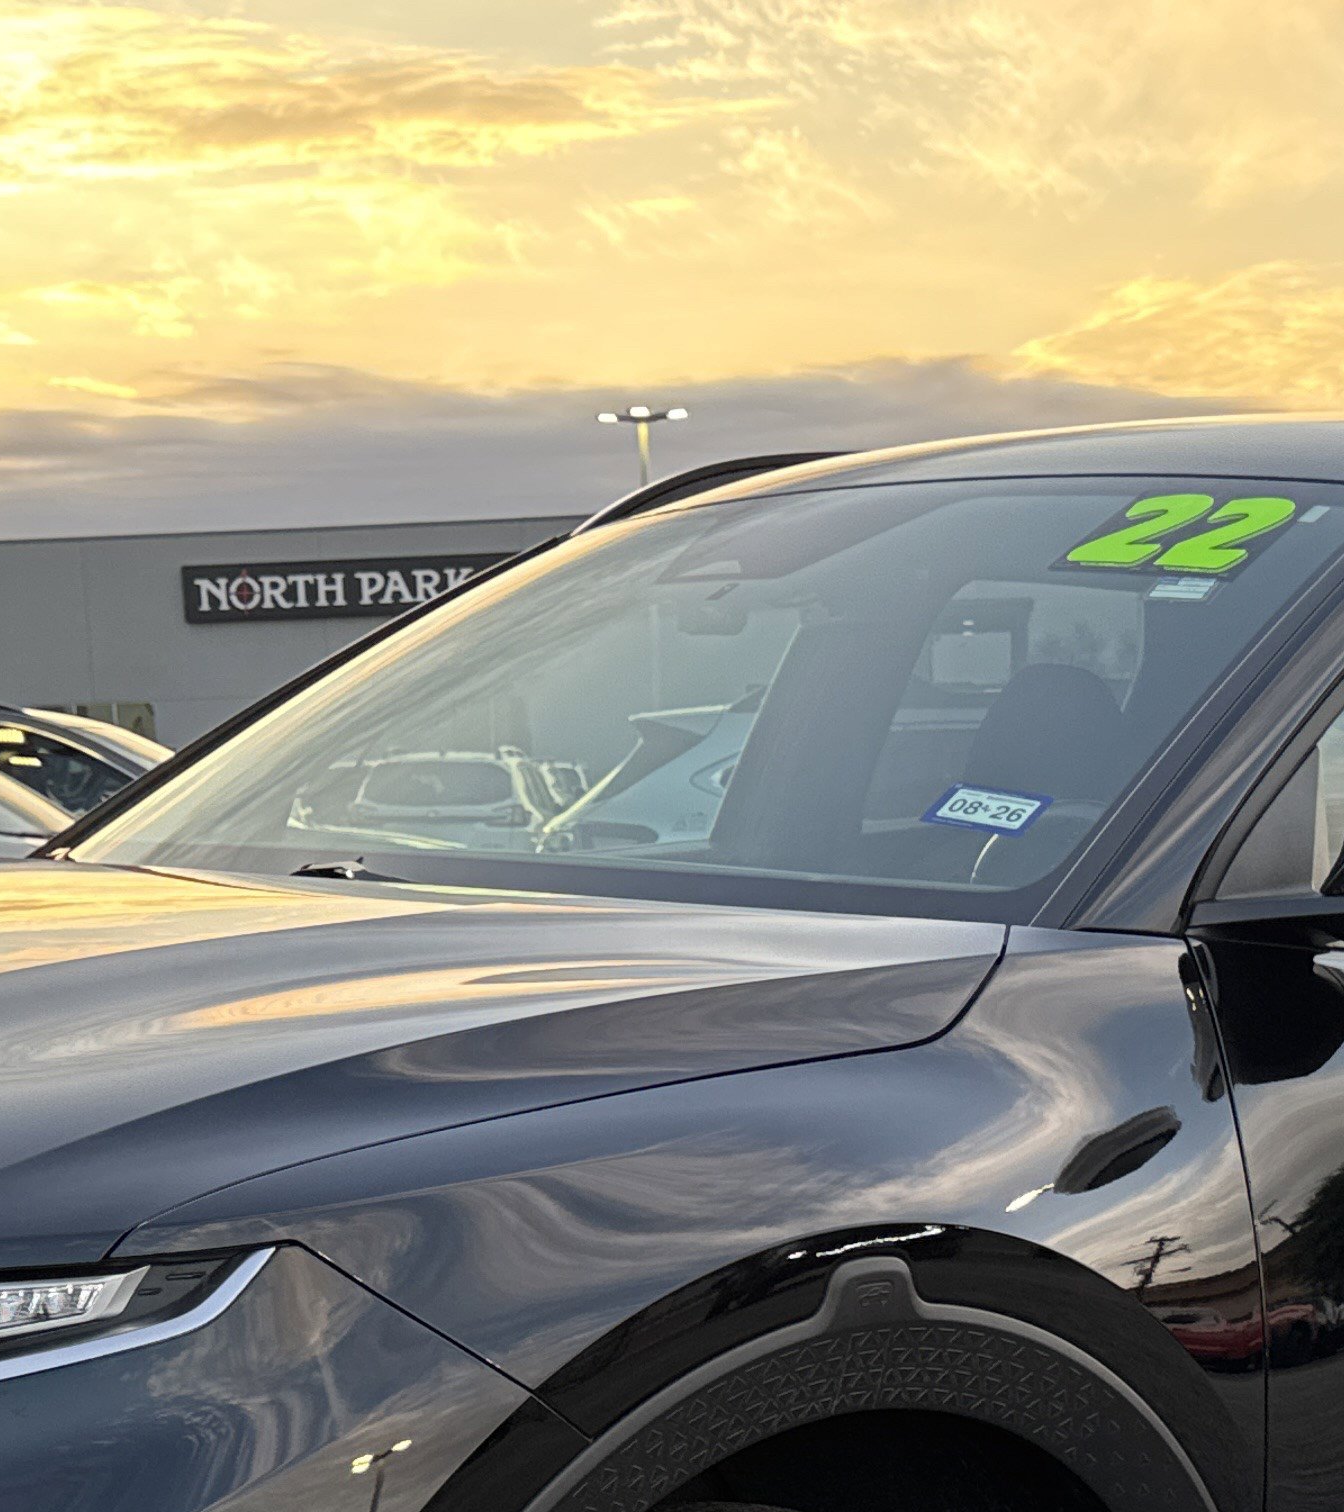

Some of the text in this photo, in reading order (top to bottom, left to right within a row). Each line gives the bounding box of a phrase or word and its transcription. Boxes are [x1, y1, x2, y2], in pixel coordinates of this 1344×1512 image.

[1067, 494, 1296, 573] 22
[193, 570, 349, 613] NORTH
[948, 798, 983, 815] 08
[988, 805, 1027, 822] 26
